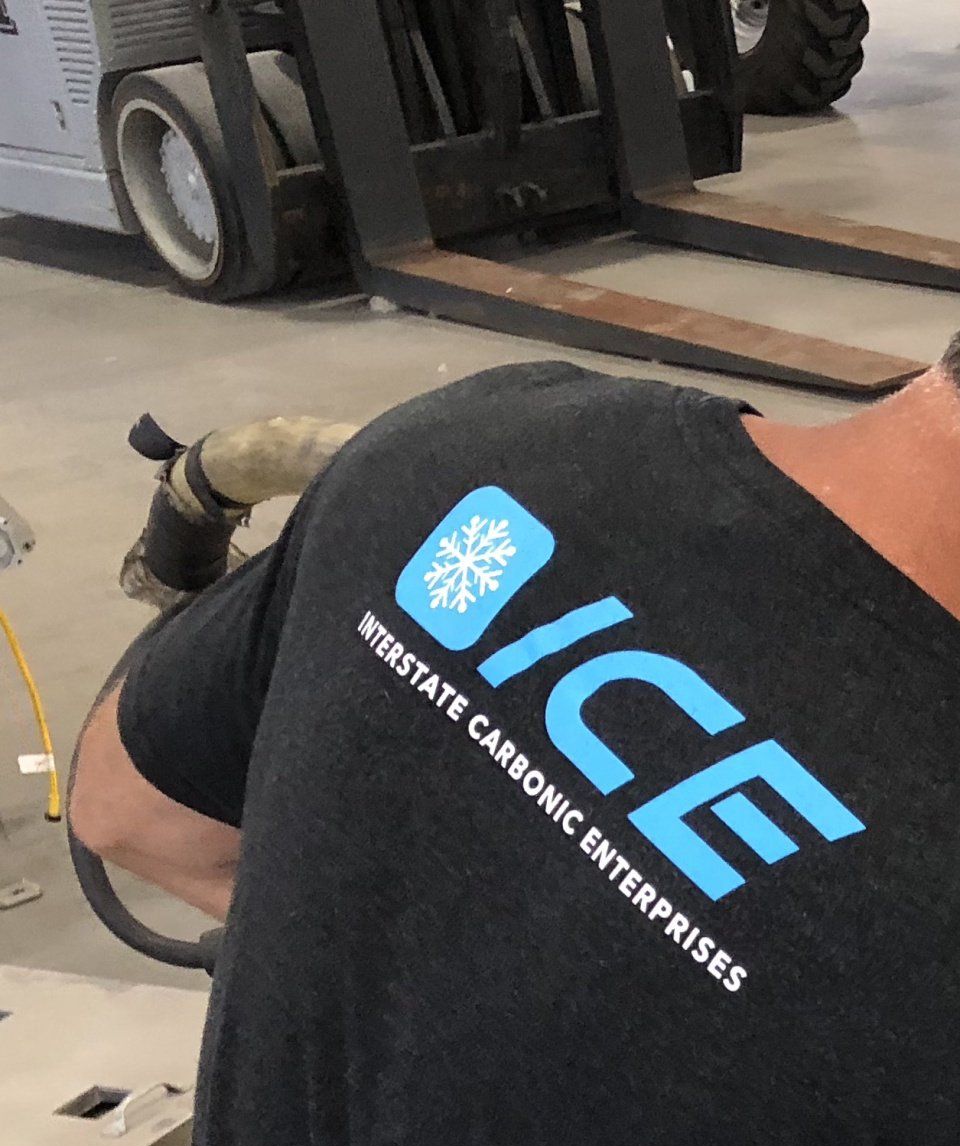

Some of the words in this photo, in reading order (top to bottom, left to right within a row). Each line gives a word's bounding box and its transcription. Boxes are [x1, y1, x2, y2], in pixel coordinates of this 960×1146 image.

[357, 610, 469, 722] INTERSTATE
[466, 712, 586, 838] CARBONIC
[579, 825, 749, 994] ENTERPRISES
[475, 594, 868, 903] ICE
